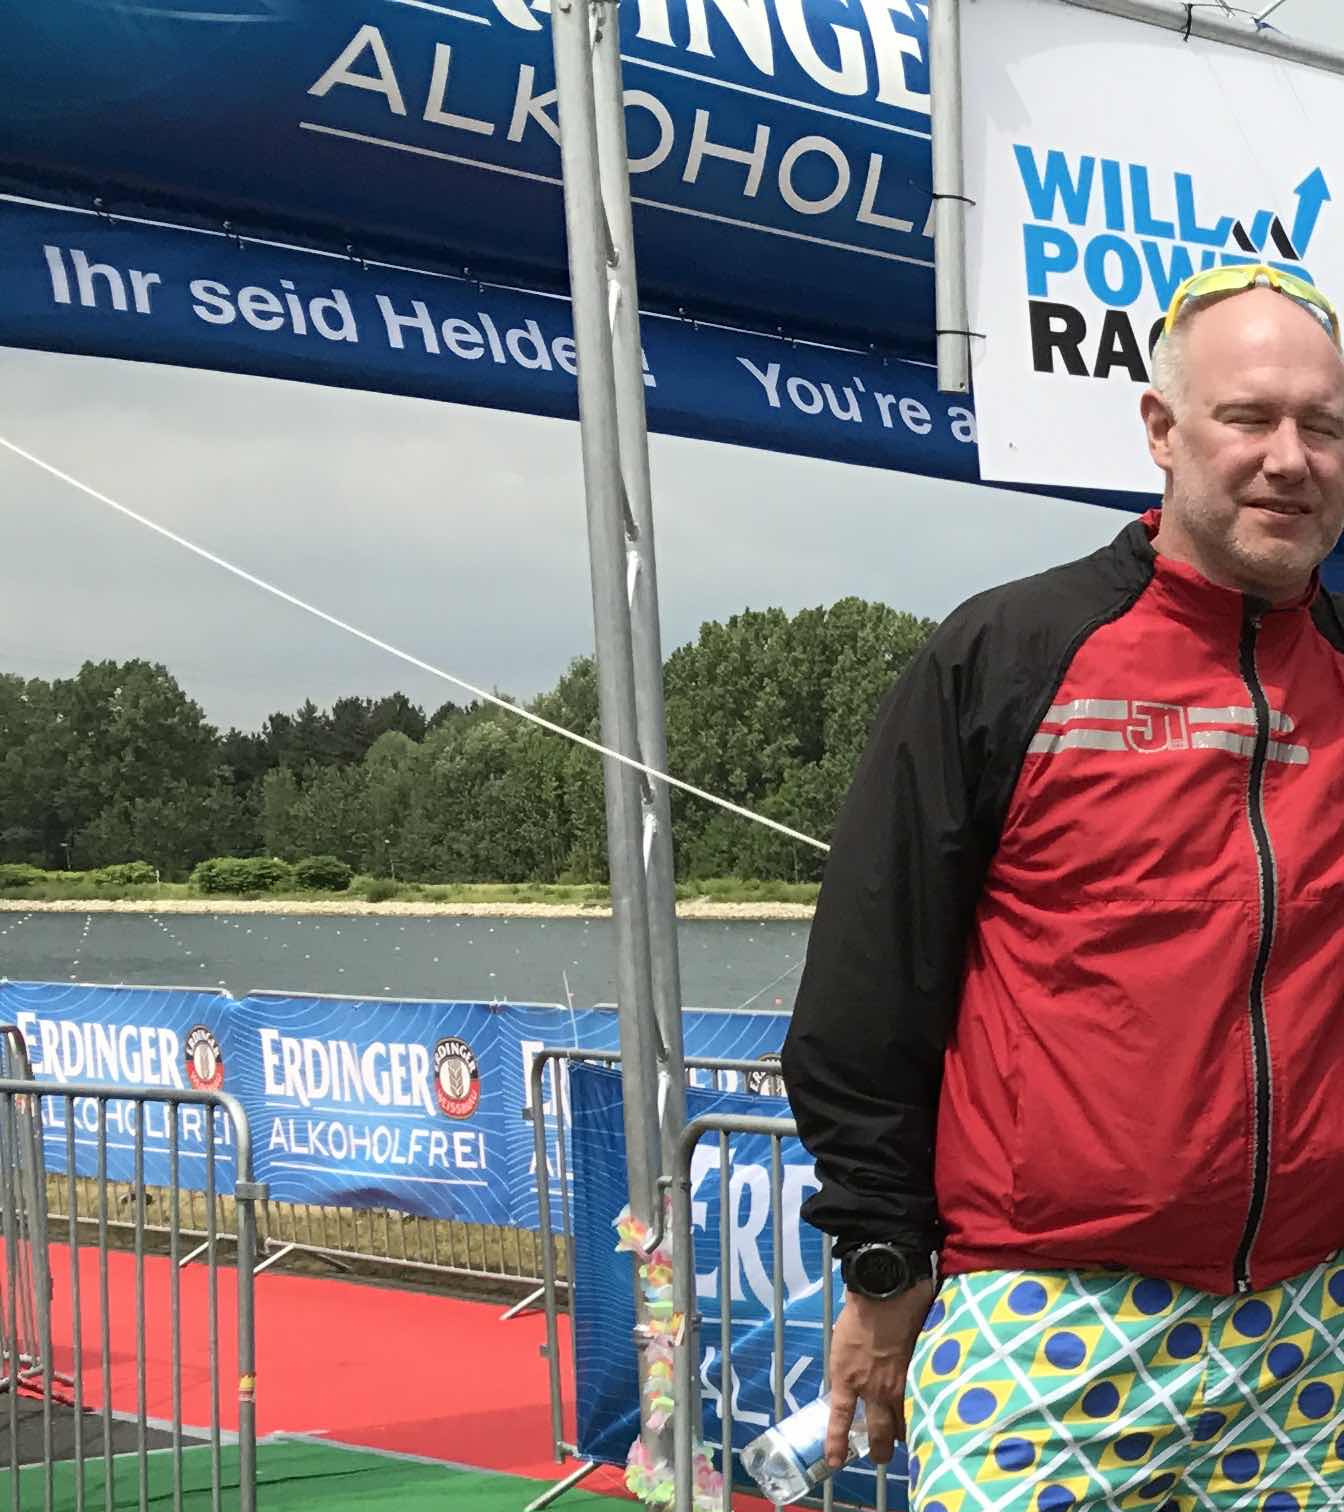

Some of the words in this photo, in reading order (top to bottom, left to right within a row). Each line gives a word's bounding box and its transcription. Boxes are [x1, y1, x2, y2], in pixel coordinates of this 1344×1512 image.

[308, 24, 936, 238] ALKOHOL
[1012, 143, 1236, 248] WILL
[43, 244, 161, 314] Ihr
[189, 279, 359, 343] seid
[1022, 223, 1316, 313] POW
[1028, 299, 1167, 383] RA
[735, 356, 932, 435] You're
[260, 1028, 436, 1117] ERDINGER
[269, 1116, 488, 1170] ALKOHOLFREI
